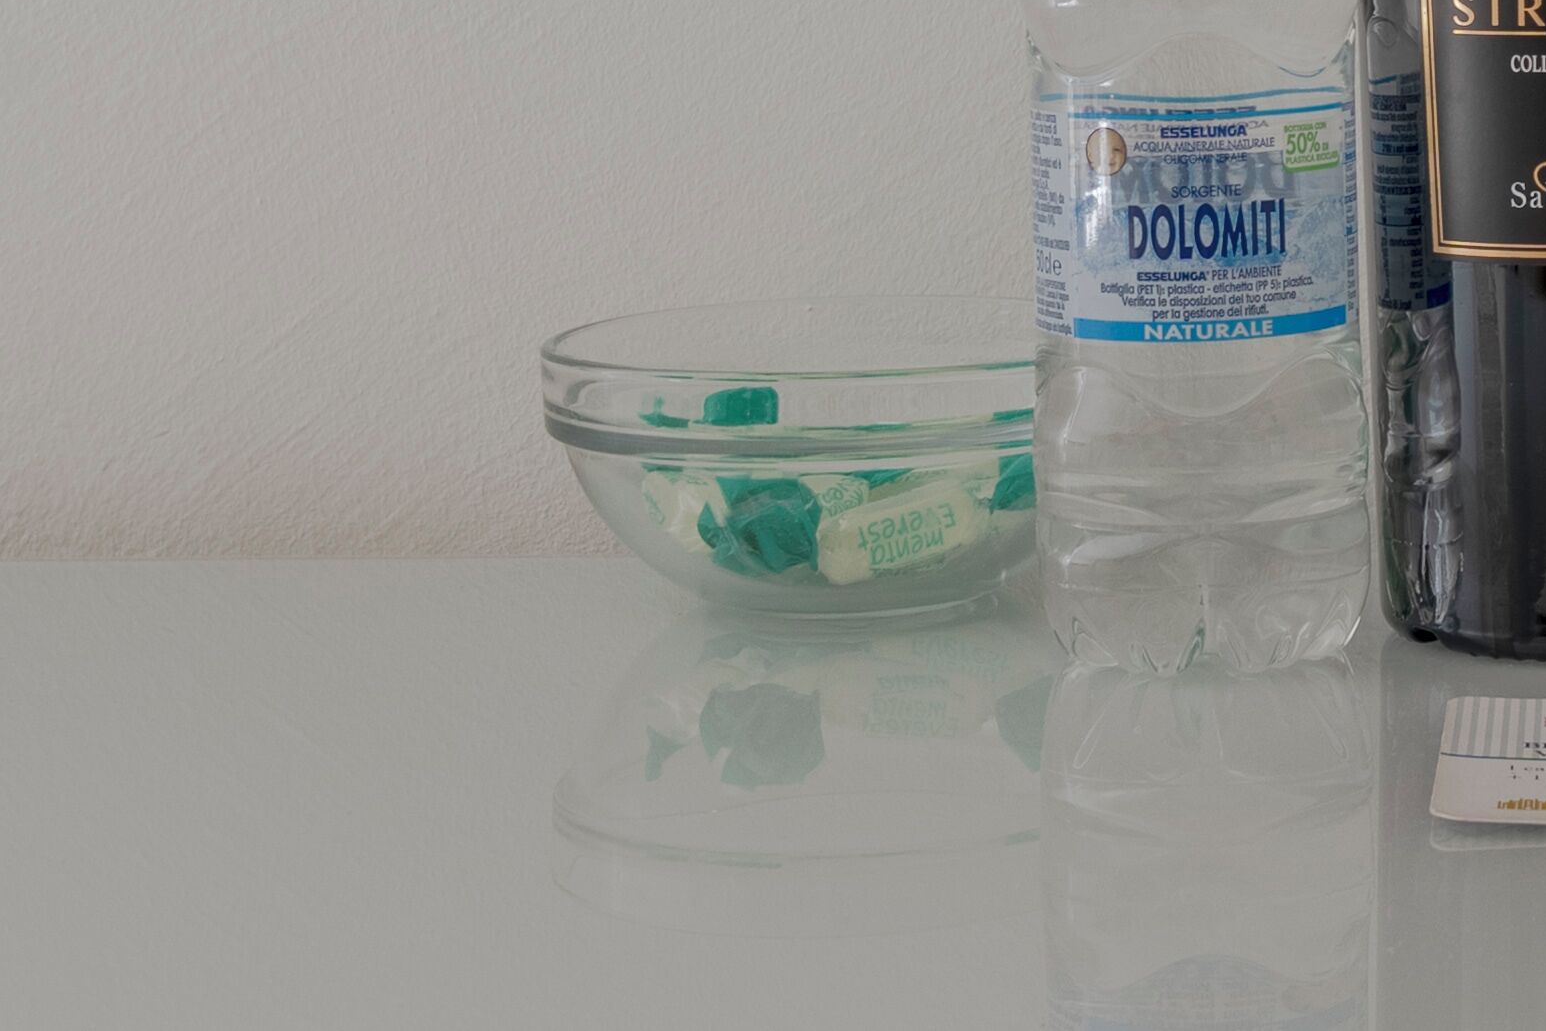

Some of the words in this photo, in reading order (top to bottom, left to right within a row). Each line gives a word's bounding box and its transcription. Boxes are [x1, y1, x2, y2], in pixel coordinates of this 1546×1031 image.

[1160, 126, 1247, 139] ESSELUNGA
[1133, 140, 1172, 153] ACQUA
[1174, 138, 1225, 153] MINERALE
[1226, 136, 1276, 151] NATURALE
[1285, 131, 1321, 155] 50%
[1171, 183, 1242, 199] SORGENTE
[1127, 198, 1286, 261] DOLOMITI
[1212, 269, 1229, 281] PER
[1231, 265, 1282, 280] L'AMBIENTE
[1100, 282, 1135, 297] Bottiglia
[1136, 284, 1155, 295] (PET
[1168, 283, 1205, 297] plastica
[1213, 281, 1254, 294] etichetta
[1255, 280, 1269, 293] (PP
[1122, 294, 1156, 307] Verifica
[1158, 295, 1168, 307] le
[1169, 293, 1227, 310] disposizioni
[1245, 292, 1261, 304] tuo
[1262, 290, 1297, 303] comune
[1152, 309, 1169, 322] per
[1170, 308, 1181, 320] la
[1183, 307, 1225, 322] gestione
[1143, 320, 1274, 341] NATURALE
[869, 527, 944, 566] menta
